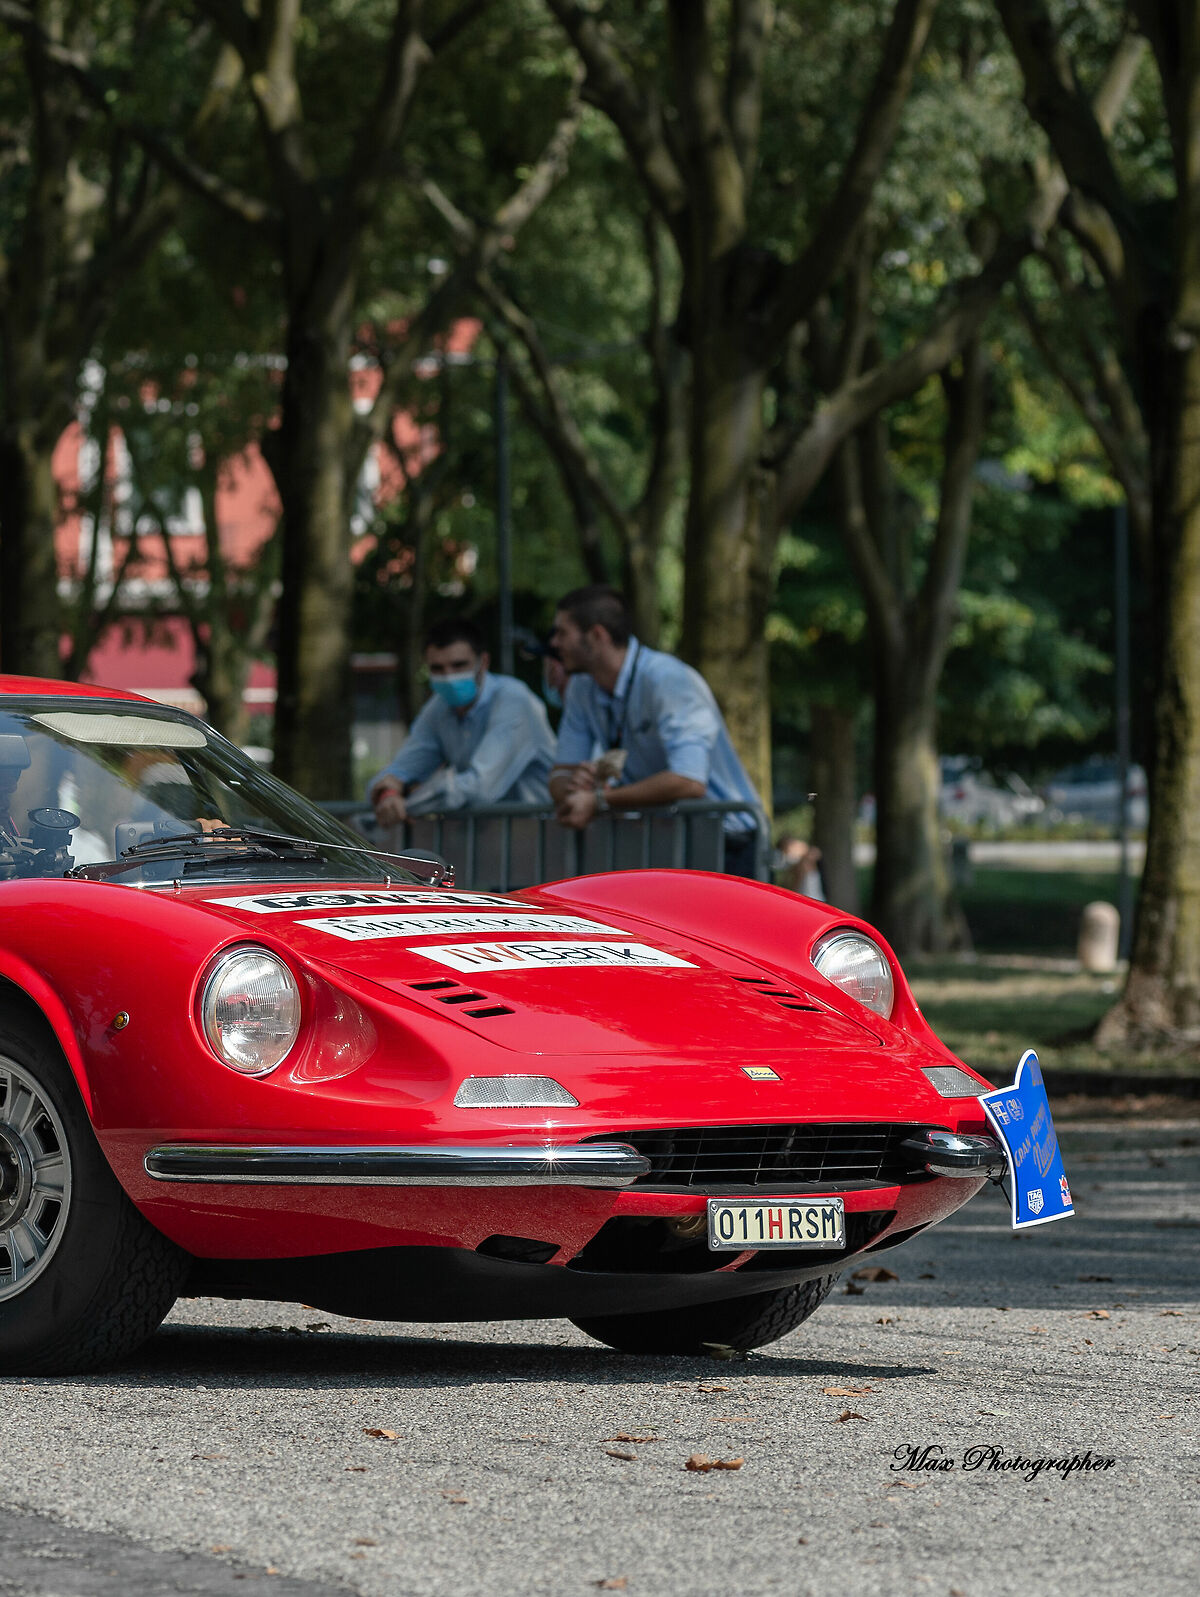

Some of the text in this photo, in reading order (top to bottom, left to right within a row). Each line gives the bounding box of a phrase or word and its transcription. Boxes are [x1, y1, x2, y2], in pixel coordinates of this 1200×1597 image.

[252, 894, 531, 908] GOWELL
[333, 919, 600, 934] IMPERFOGLIA
[719, 1208, 836, 1239] 011HRSM
